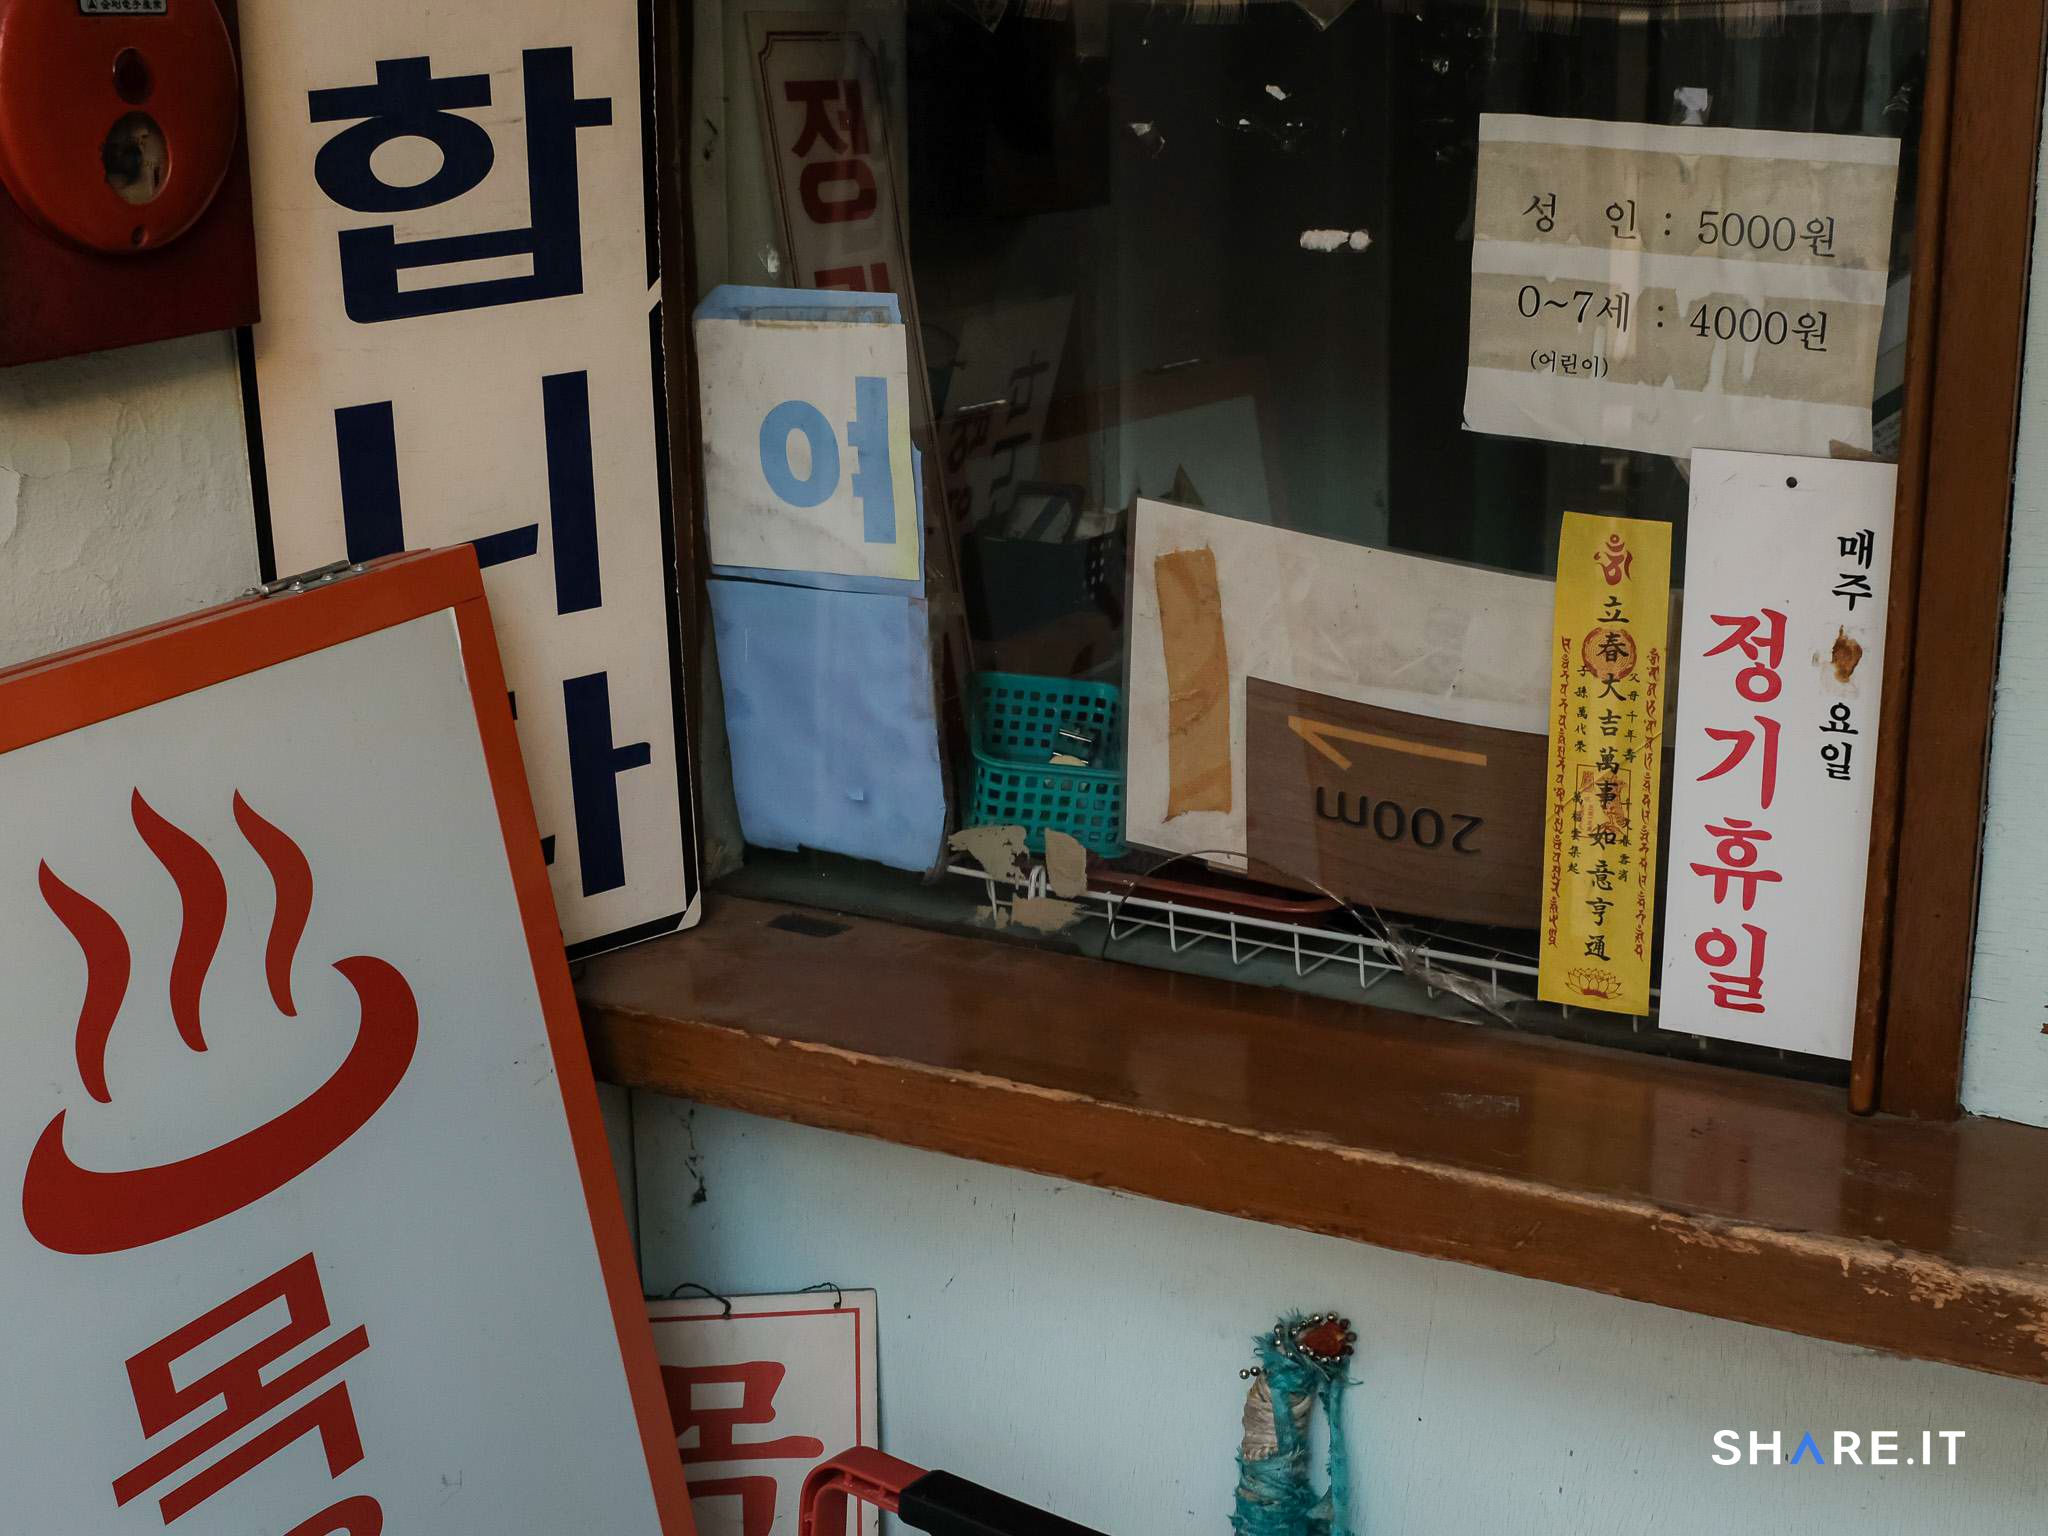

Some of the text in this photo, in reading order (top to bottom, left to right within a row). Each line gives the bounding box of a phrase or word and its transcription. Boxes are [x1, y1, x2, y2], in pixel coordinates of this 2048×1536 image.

[1697, 209, 1837, 258] 5000원
[1517, 284, 1630, 333] 0~7세
[1690, 303, 1828, 353] 4000원
[1529, 349, 1609, 379] (어린이)
[759, 376, 897, 545] 여
[1818, 528, 1876, 782] 매주 요일
[1315, 785, 1488, 855] 200m
[1584, 595, 1631, 962] 立春大吉萬事如意亨通
[1688, 606, 1788, 1015] 정기휴일
[112, 1252, 384, 1536] 목
